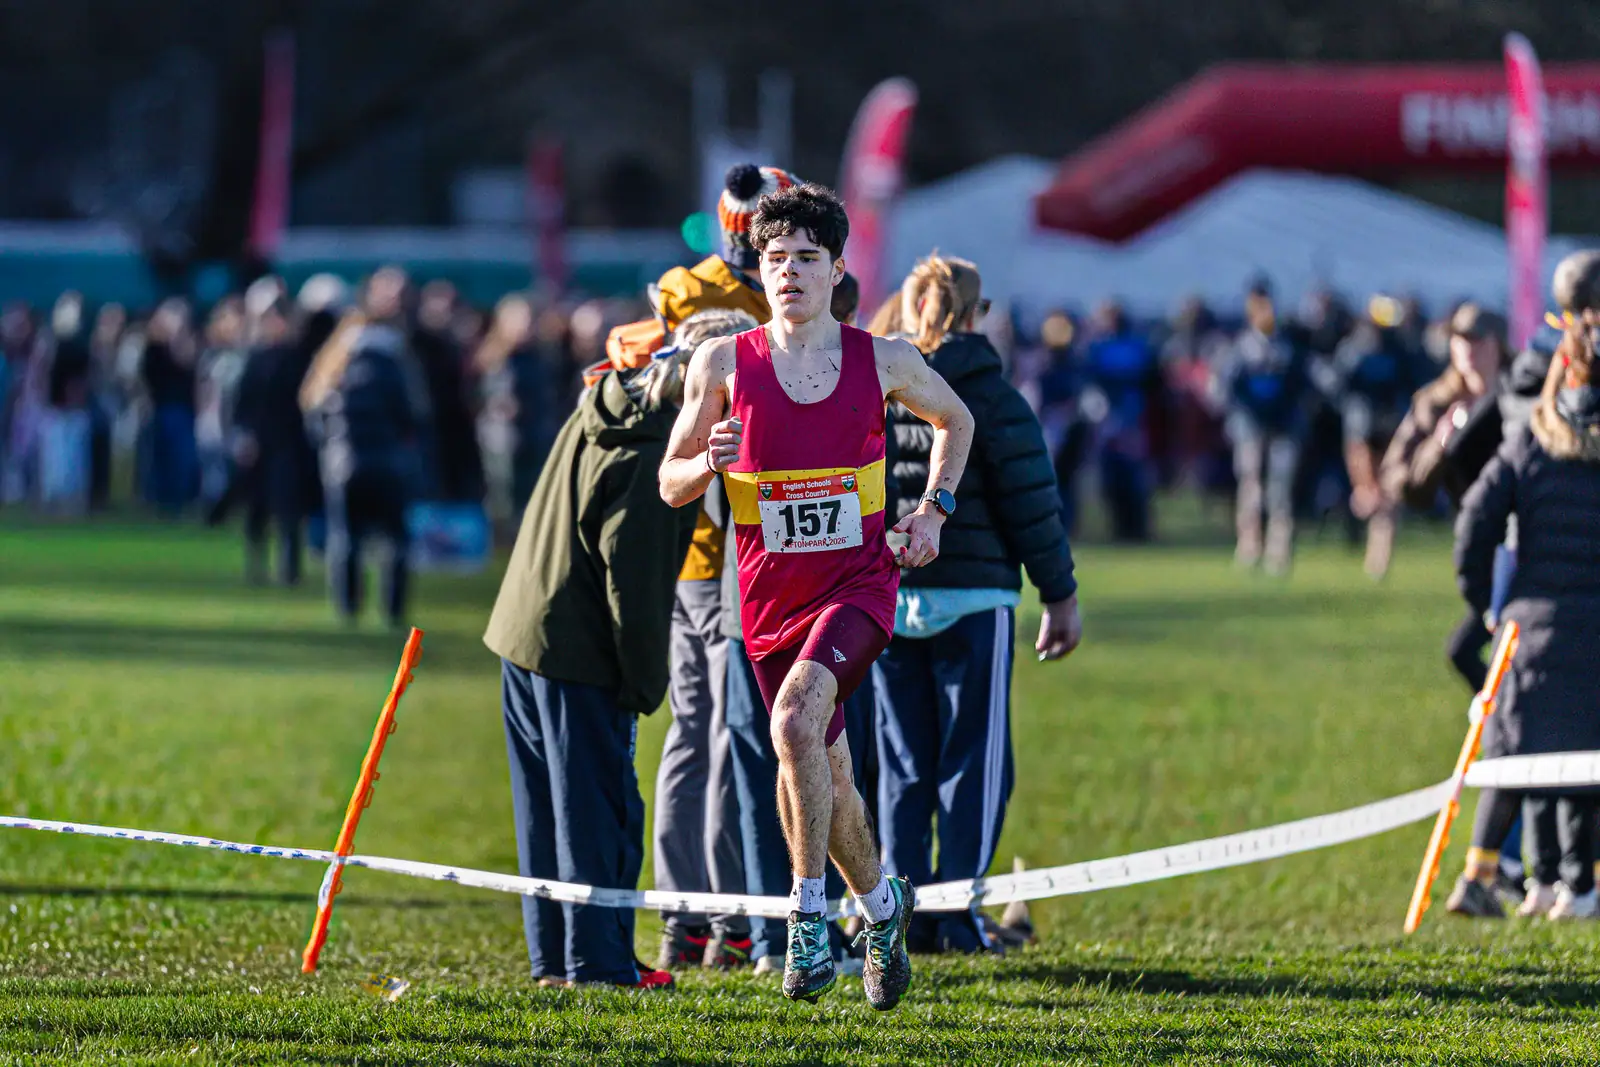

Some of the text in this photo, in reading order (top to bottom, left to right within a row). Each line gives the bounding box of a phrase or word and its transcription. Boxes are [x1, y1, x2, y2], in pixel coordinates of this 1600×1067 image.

[782, 479, 832, 491] English Schools
[805, 490, 830, 498] Country
[779, 500, 841, 537] 157
